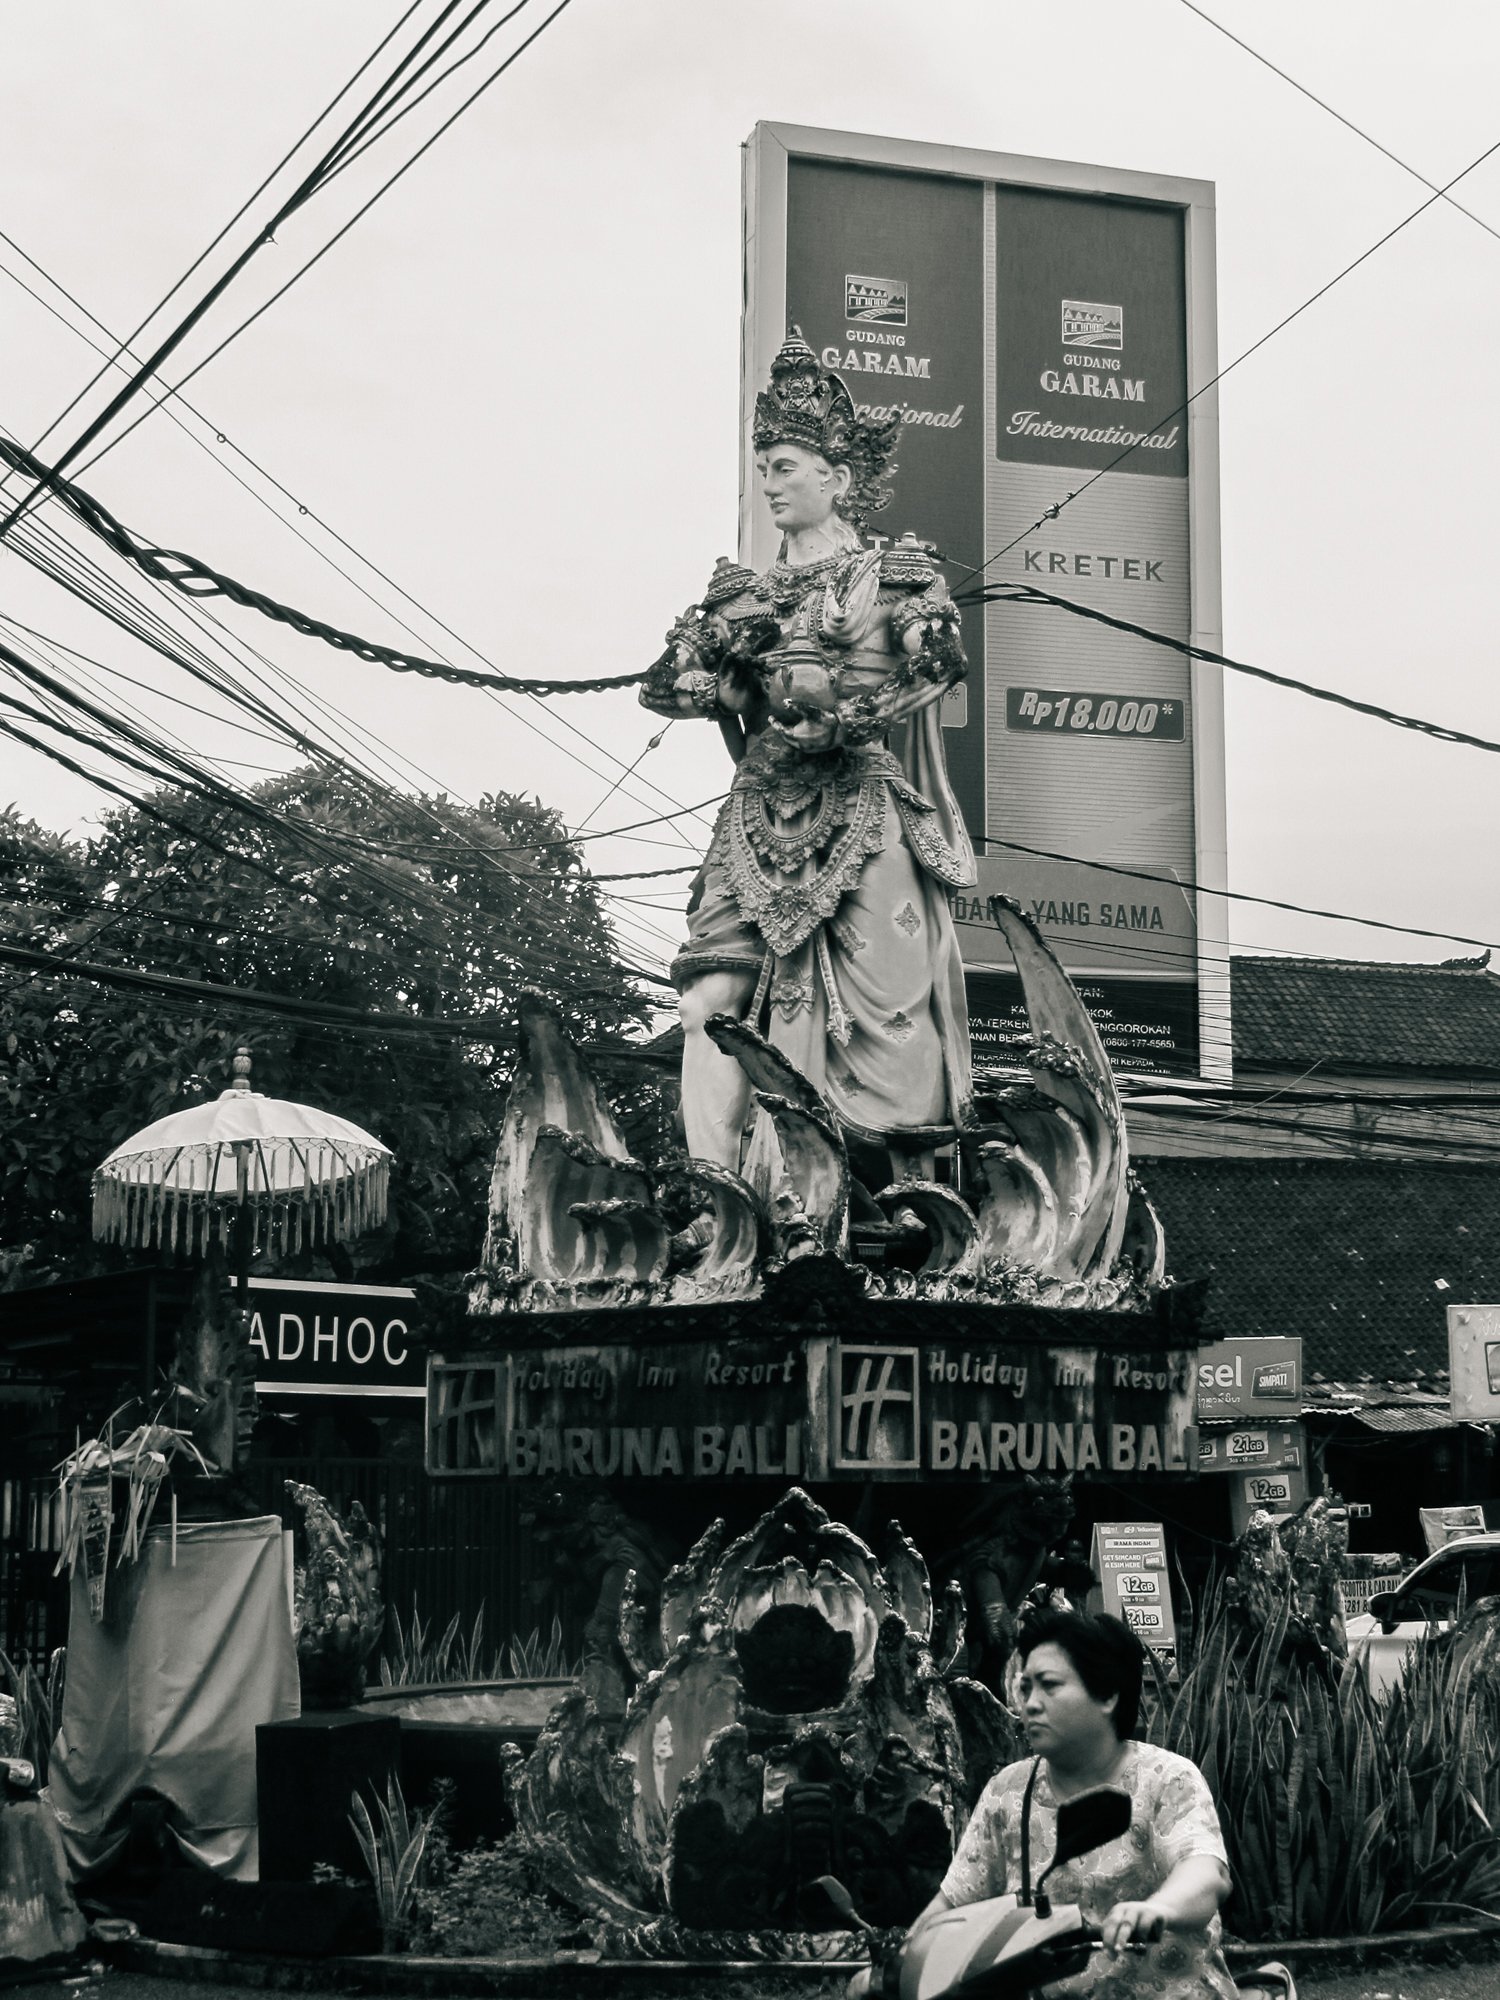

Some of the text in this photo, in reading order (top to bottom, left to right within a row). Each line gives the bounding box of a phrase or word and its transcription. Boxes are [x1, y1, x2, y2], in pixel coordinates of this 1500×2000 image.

[846, 330, 906, 347] GUDANG
[822, 348, 930, 379] GARAM
[1063, 354, 1121, 370] GUDANG
[1040, 370, 1145, 402] GARAM
[855, 402, 964, 429] national
[1006, 411, 1179, 450] International
[1024, 550, 1164, 582] KRETEK
[1032, 900, 1090, 926] YANG
[1101, 903, 1164, 930] SAMA
[969, 1033, 996, 1042] ANAN
[987, 1018, 1030, 1029] TERKEN
[1094, 1022, 1170, 1034] ENGGOROKAN
[249, 1312, 407, 1366] ADHOC
[514, 1350, 796, 1400] Holiday Inn Resort
[929, 1350, 1027, 1399] Holiday
[1199, 1355, 1242, 1387] sel
[1258, 1373, 1287, 1387] SIMPATI
[509, 1424, 801, 1476] BARUNA BALI
[931, 1420, 1200, 1472] BARUNA BALI
[1233, 1435, 1264, 1453] 21GB
[1250, 1479, 1285, 1498] 12GB
[1123, 1577, 1155, 1592] 12GB
[1127, 1609, 1159, 1626] 21GB
